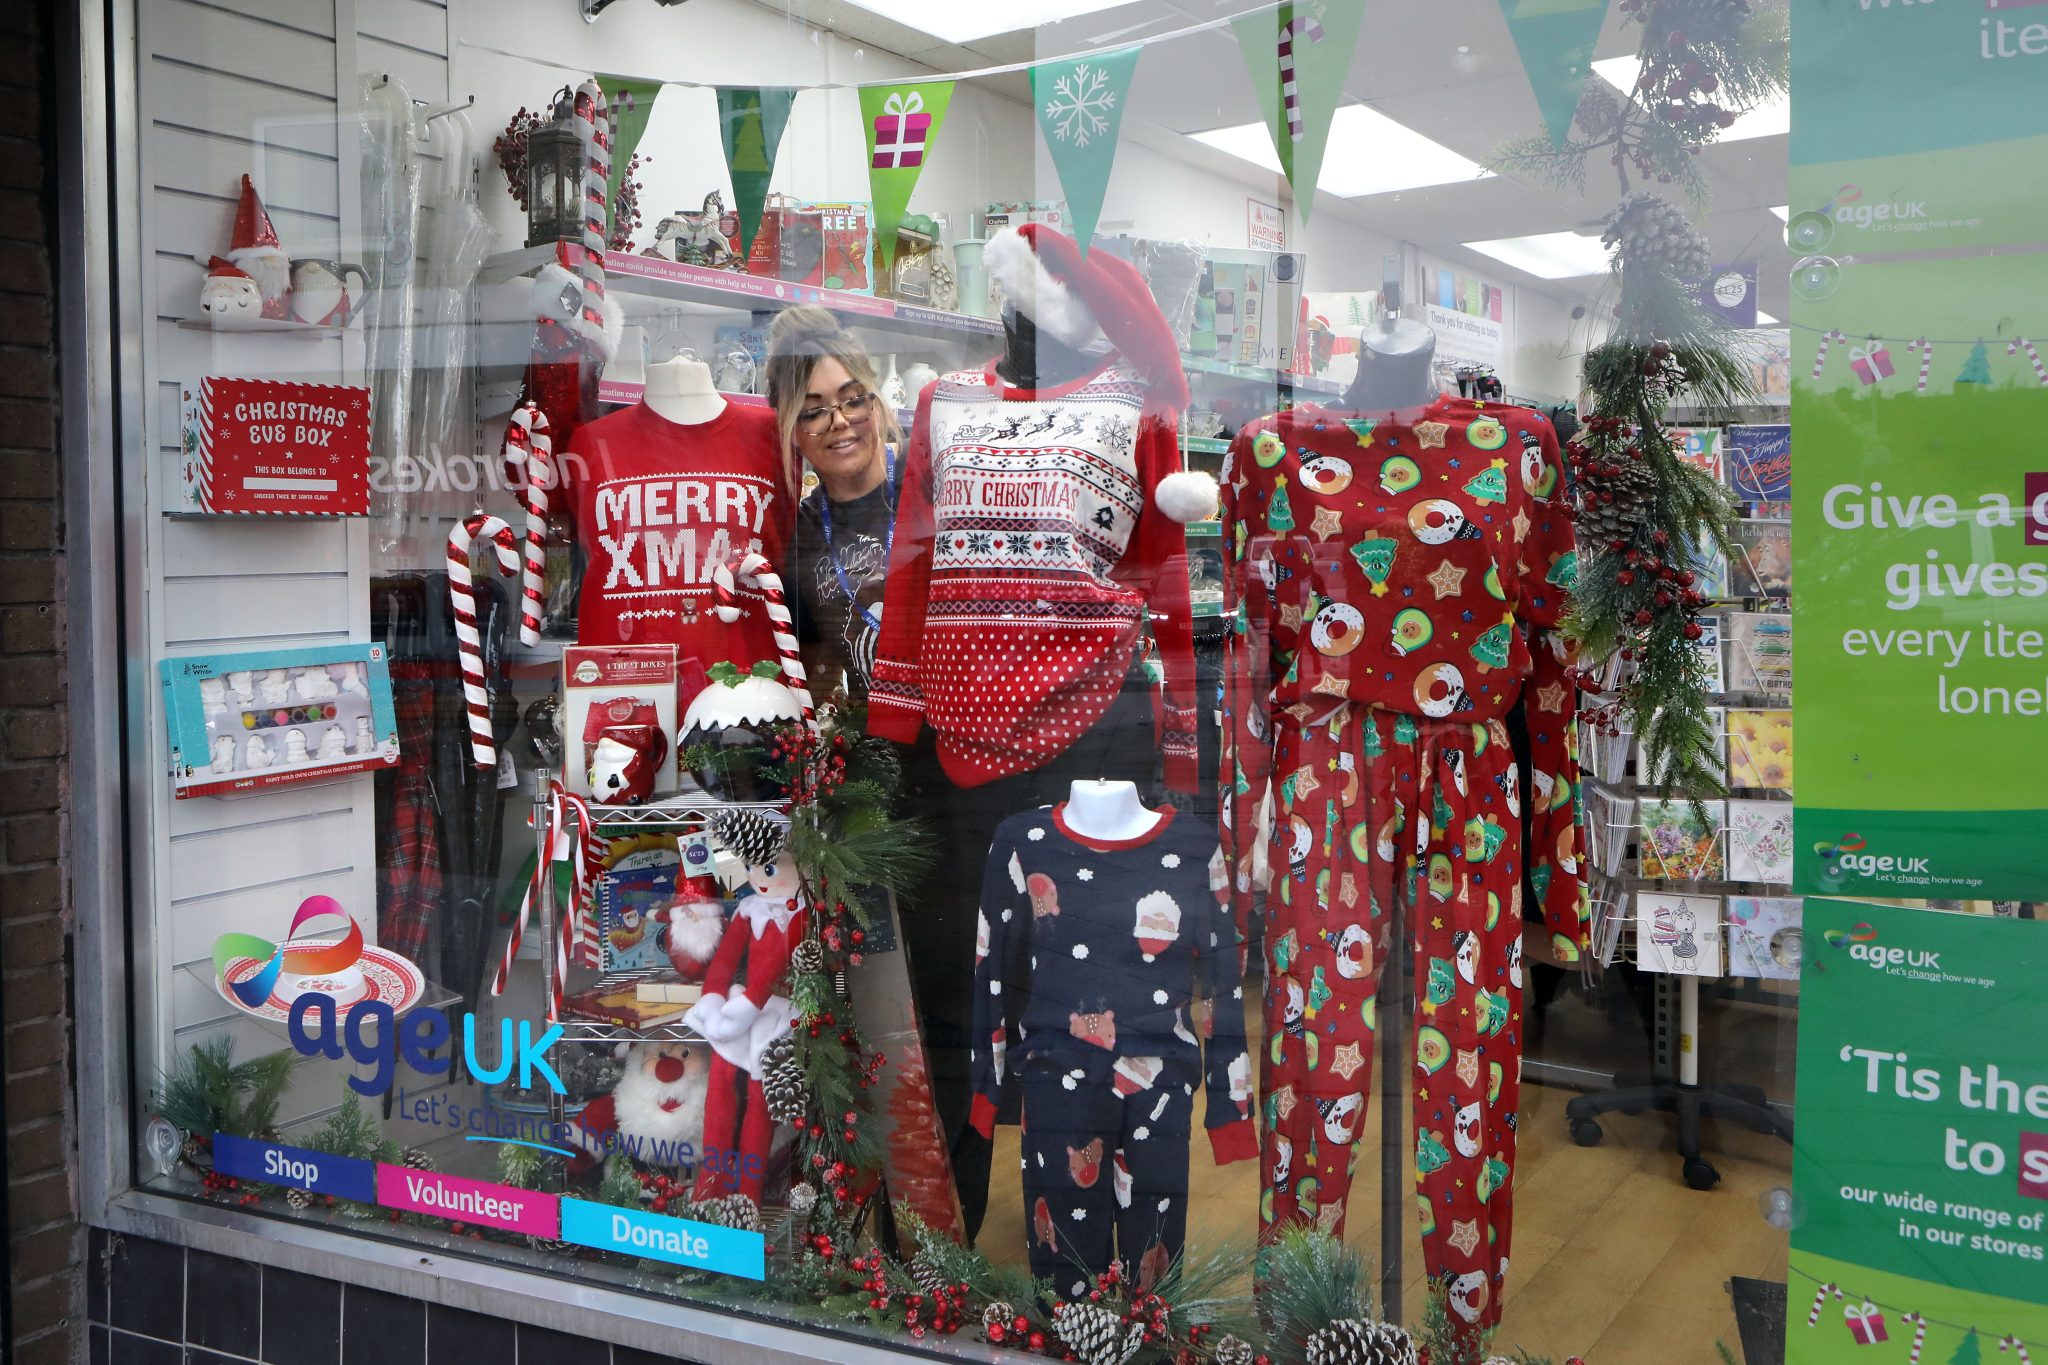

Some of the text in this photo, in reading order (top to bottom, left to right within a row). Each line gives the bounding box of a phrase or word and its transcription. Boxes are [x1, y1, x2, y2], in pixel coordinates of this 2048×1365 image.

[823, 216, 858, 230] REE
[1835, 201, 1926, 229] age UK
[1250, 223, 1283, 244] WARNING
[1259, 239, 1271, 248] HOUR
[626, 262, 644, 271] could
[644, 265, 668, 277] provide
[677, 270, 693, 281] older
[693, 274, 714, 286] person
[714, 276, 727, 285] with
[727, 278, 740, 289] help
[747, 282, 763, 291] home
[1431, 310, 1445, 325] Thank
[1446, 317, 1455, 329] you
[1464, 320, 1481, 337] visiting
[599, 388, 643, 399] onation could
[235, 401, 348, 428] CHRISTMAS
[249, 425, 333, 447] EVE BOX
[254, 466, 327, 476] THIS BOX BELONGS TO
[595, 480, 775, 533] MERRY
[982, 481, 1080, 512] CHRISTMAS
[1822, 482, 1958, 530] Give
[1975, 492, 2016, 528] a
[1885, 549, 2048, 611] gives
[1842, 628, 1971, 668] every
[1938, 674, 2048, 715] lone
[1839, 853, 1930, 877] age UK
[1875, 873, 1896, 882] Let's
[1897, 874, 1930, 884] change
[1931, 875, 1950, 884] how
[1965, 878, 1983, 887] age
[1849, 943, 1941, 969] age UK
[1886, 965, 1995, 989] Let's change how we age
[287, 992, 569, 1097] age UK
[1959, 1064, 2048, 1119] the
[400, 1087, 763, 1189] Let's change how we age
[1944, 1127, 2006, 1176] to
[264, 1148, 319, 1189] Shop
[406, 1175, 524, 1223] Volunteer
[1839, 1185, 2045, 1232] our wide range of
[611, 1214, 709, 1259] Donate
[1899, 1218, 2045, 1261] in our stores
